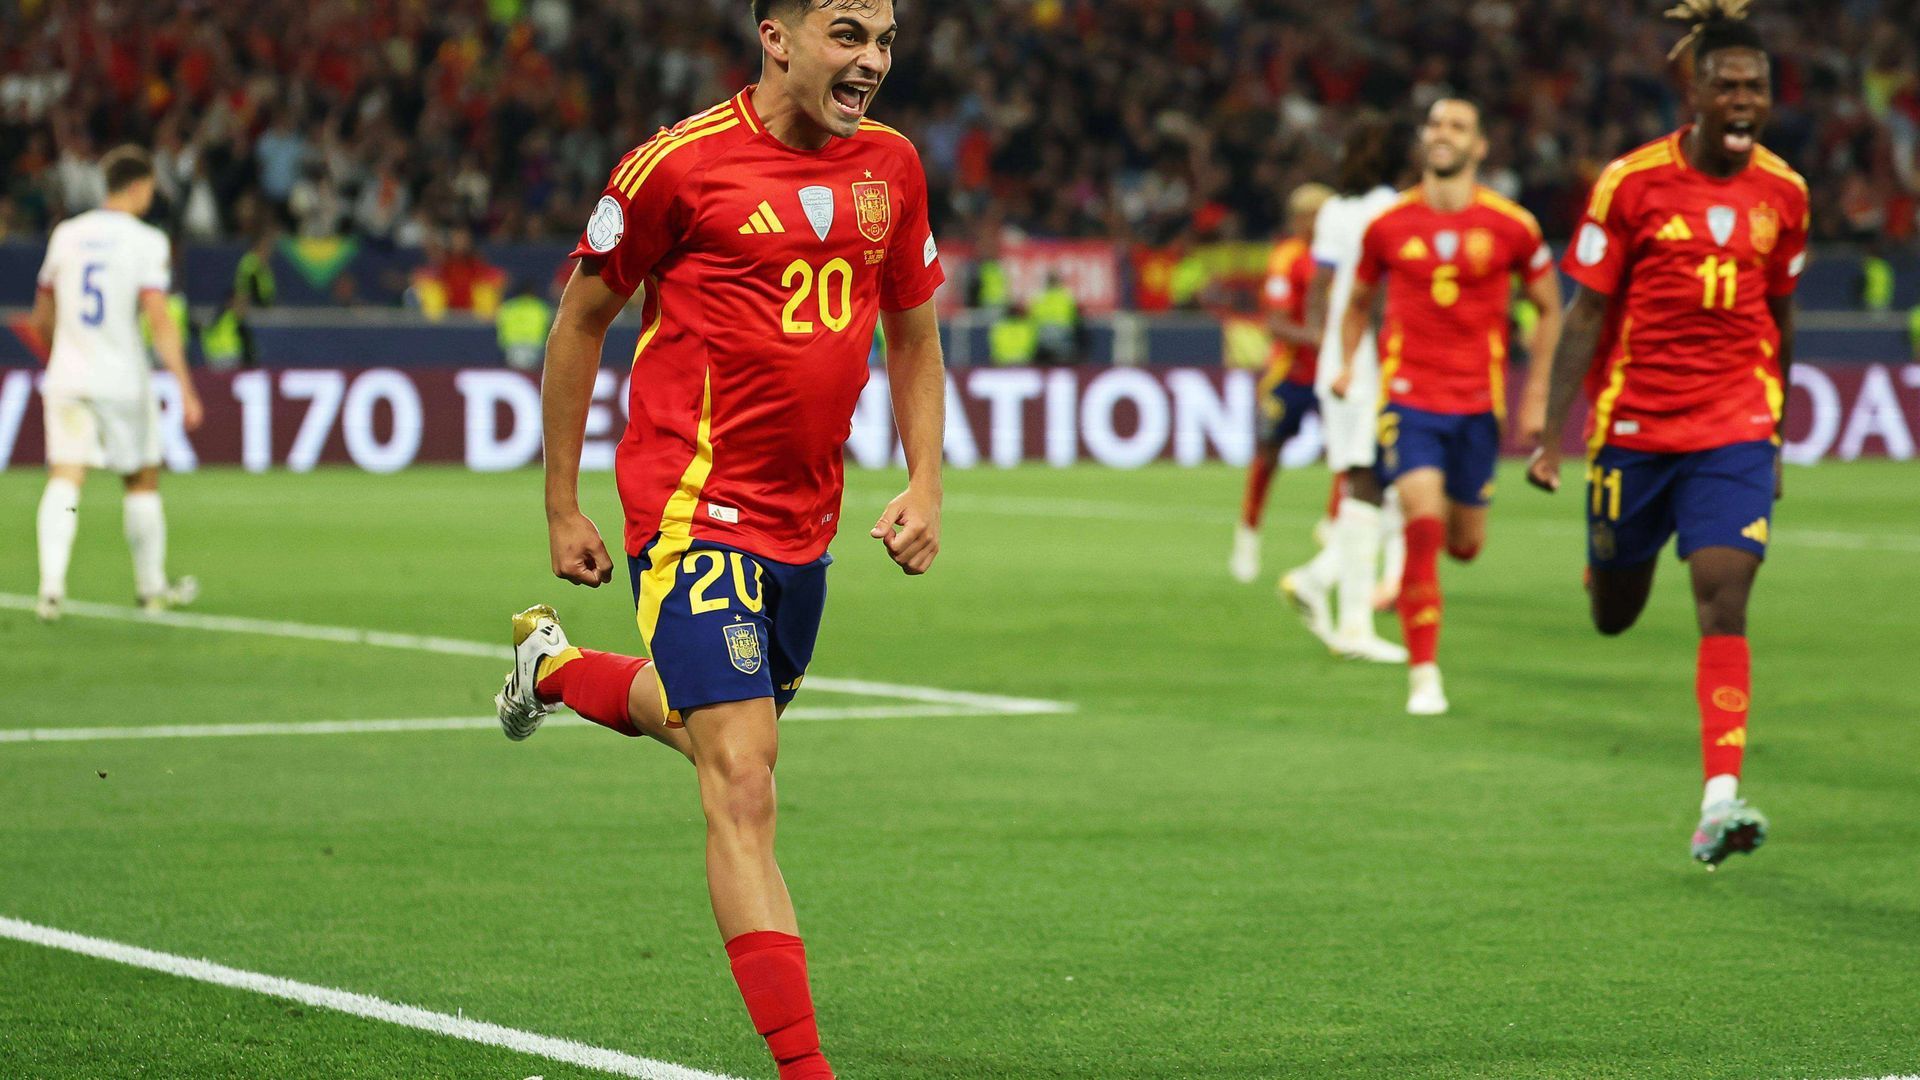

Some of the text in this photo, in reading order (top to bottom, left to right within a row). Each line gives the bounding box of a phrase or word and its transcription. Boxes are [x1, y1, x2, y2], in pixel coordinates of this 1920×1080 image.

[80, 262, 105, 328] 5
[781, 257, 853, 333] 20
[1430, 264, 1461, 308] 6
[1695, 255, 1738, 310] 11
[230, 368, 424, 474] 170
[1591, 464, 1622, 521] 11
[682, 549, 764, 615] 20
